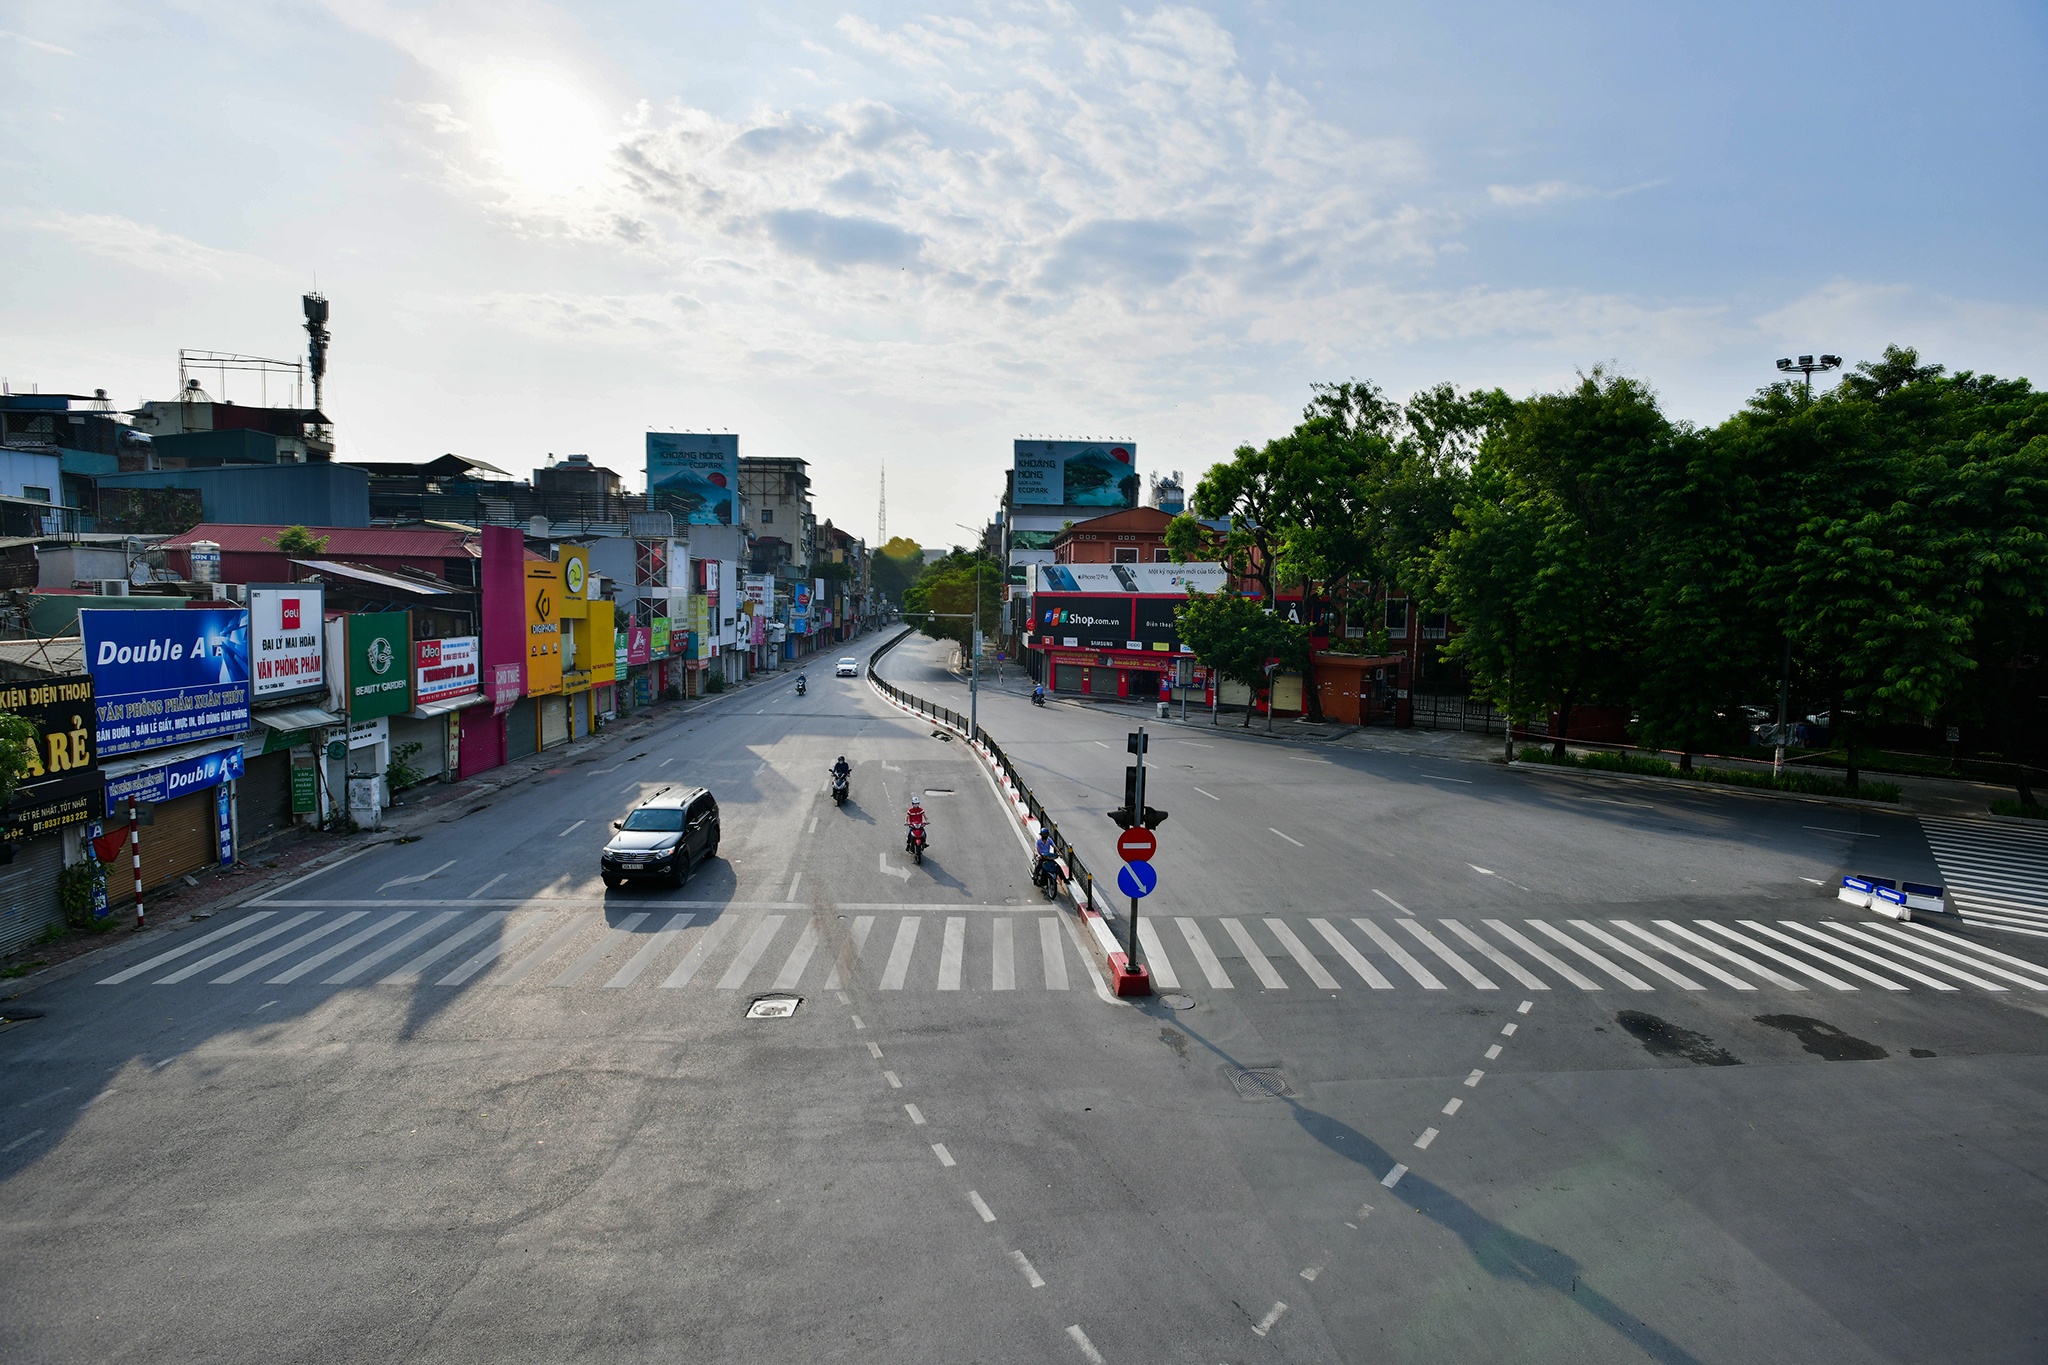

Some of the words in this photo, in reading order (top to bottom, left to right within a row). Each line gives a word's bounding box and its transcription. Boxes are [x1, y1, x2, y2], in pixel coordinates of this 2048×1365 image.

[660, 449, 696, 460] KHOÁNG
[699, 450, 724, 460] NÓNG
[1018, 457, 1056, 468] KHOÁNG
[1018, 468, 1043, 479] NÓNG
[284, 609, 298, 618] deli
[532, 623, 558, 634] DIGIPHONE
[262, 639, 274, 652] ĐẠI
[276, 635, 282, 649] LÝ
[285, 638, 298, 648] MAI
[300, 633, 316, 648] HOÀN
[97, 638, 182, 666] Double
[190, 637, 206, 658] A
[257, 658, 272, 680] VĂN
[275, 654, 299, 678] PHÒNG
[301, 648, 321, 674] PHẨM
[496, 669, 507, 685] CHO
[356, 683, 380, 696] BEAUTY
[382, 680, 407, 692] GARDEN
[0, 687, 27, 712] KIỆN
[30, 684, 57, 708] ĐIỆN
[58, 682, 91, 702] THOẠI
[97, 702, 124, 722] VĂN
[126, 698, 163, 718] PHÒNG
[164, 690, 194, 714] PHẨM
[194, 690, 221, 709] XUÂN
[222, 686, 246, 705] THỦY
[96, 728, 110, 742] BÁN
[112, 724, 130, 740] BUÔN
[136, 722, 149, 736] BÁN
[150, 718, 158, 733] LẺ
[221, 710, 231, 721] VĂN
[232, 707, 248, 720] PHÒNG
[46, 715, 90, 773] RẺ
[169, 764, 214, 790] Double
[219, 758, 228, 774] A
[221, 787, 227, 797] A
[32, 807, 40, 820] RẺ
[60, 800, 71, 812] TỐT
[72, 796, 87, 810] NHẤT
[61, 815, 74, 824] 283
[75, 810, 88, 820] 222
